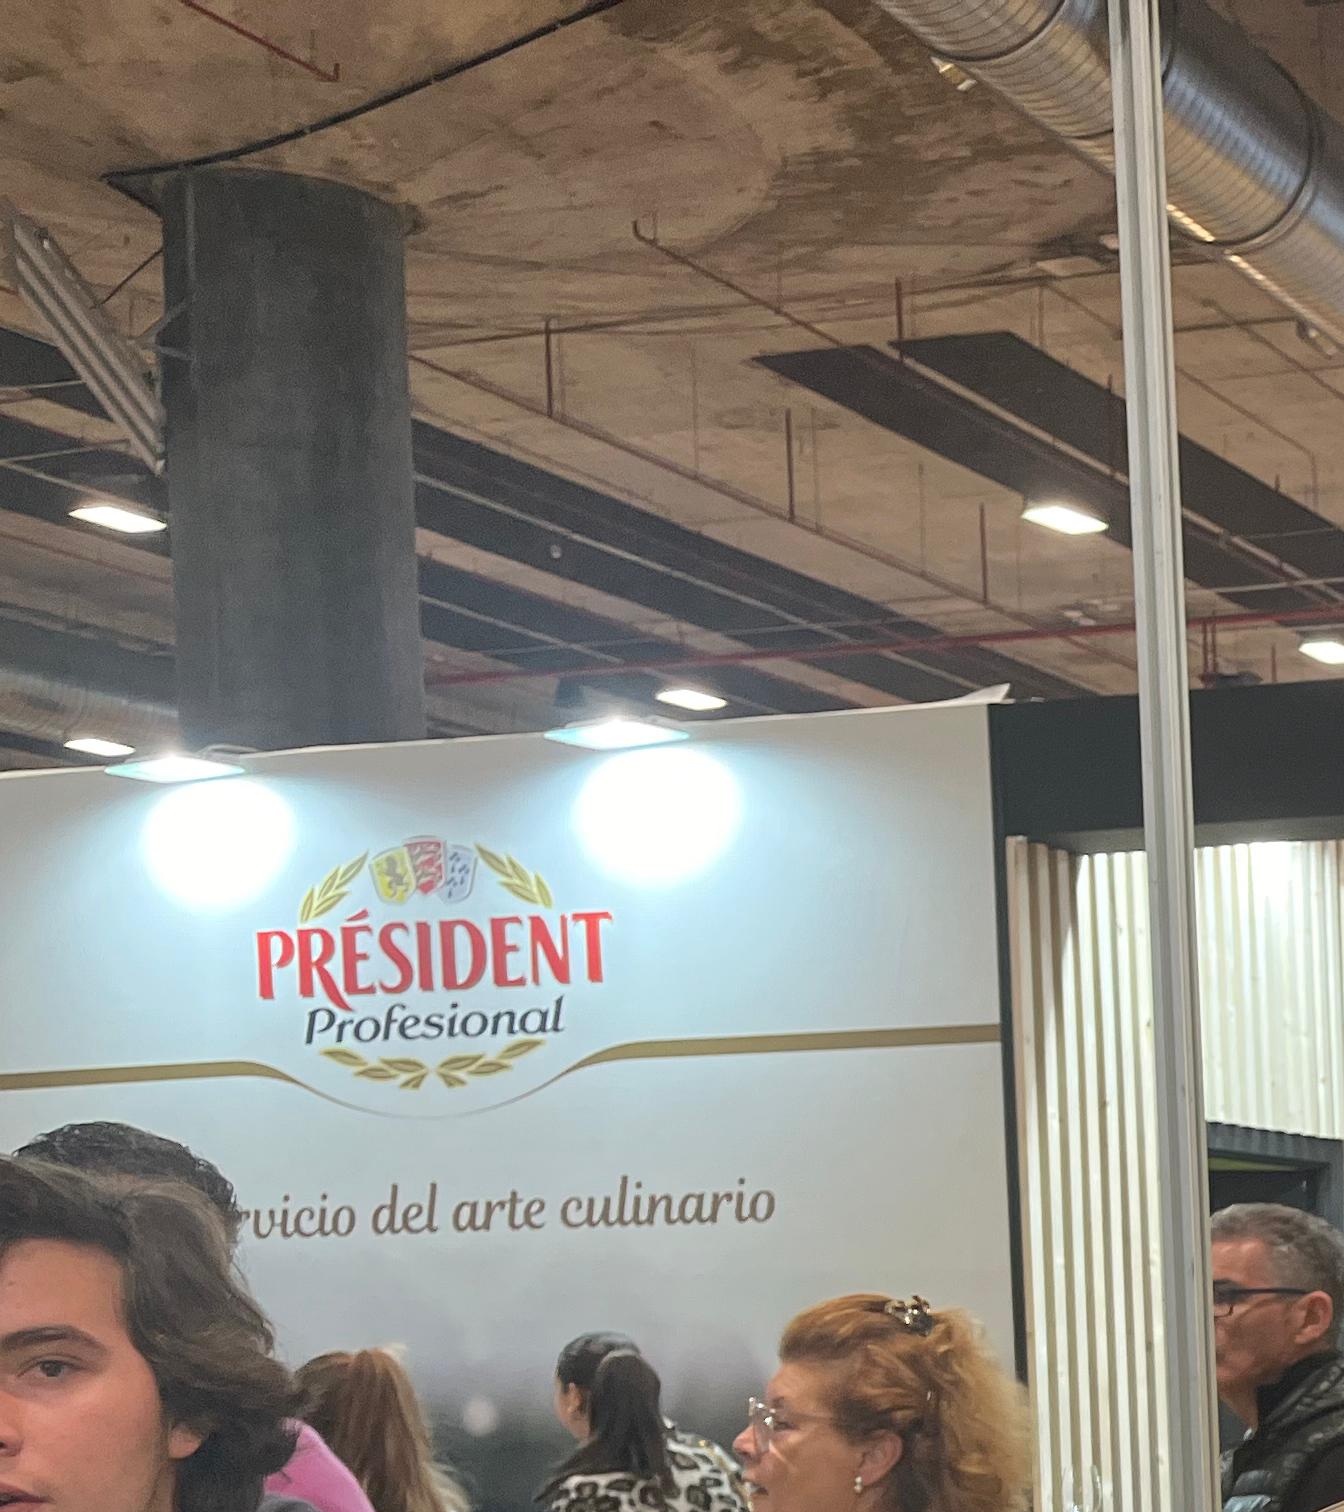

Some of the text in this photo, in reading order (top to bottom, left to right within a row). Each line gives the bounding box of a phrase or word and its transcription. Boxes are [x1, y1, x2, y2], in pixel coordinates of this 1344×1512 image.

[256, 908, 613, 1012] PRÉSIDENT
[305, 994, 565, 1044] Profesional
[238, 1174, 776, 1239] rvicio del arte culinario
